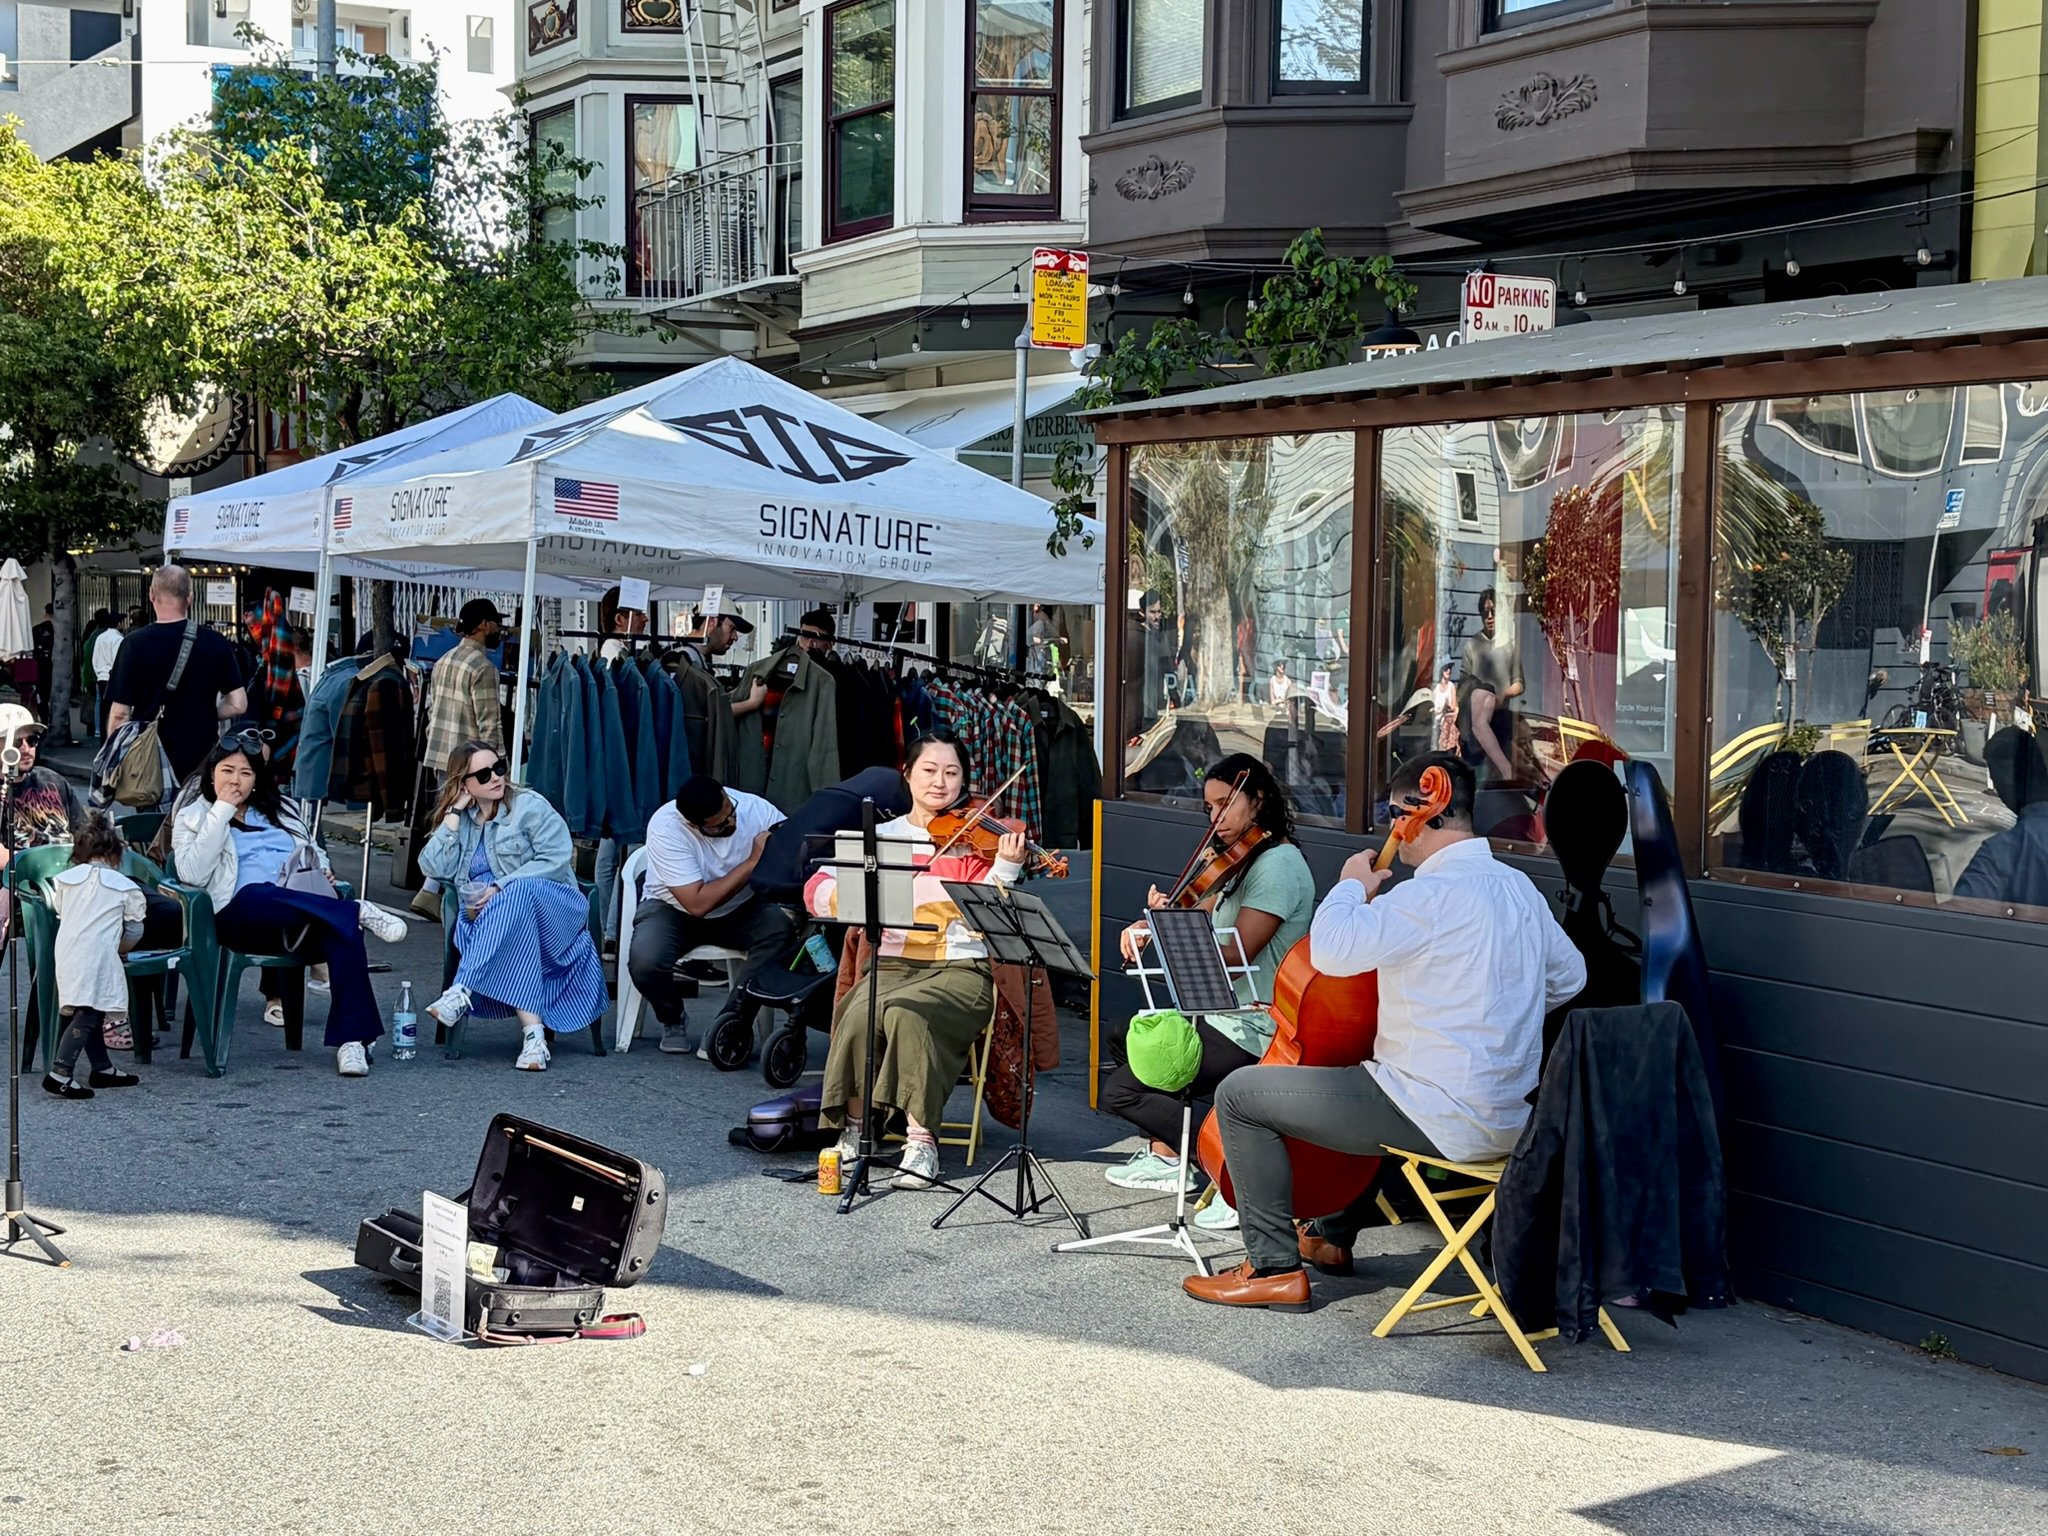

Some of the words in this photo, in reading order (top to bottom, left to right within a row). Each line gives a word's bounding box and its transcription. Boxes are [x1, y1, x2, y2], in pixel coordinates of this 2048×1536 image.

[1470, 277, 1493, 305] NO
[1497, 286, 1549, 309] PARKING
[1473, 311, 1483, 331] 8
[1513, 313, 1528, 333] 10
[215, 502, 264, 530] SIGNATURE
[390, 486, 452, 522] SIGNATURE
[759, 503, 933, 556] SIGNATURE
[756, 541, 867, 566] INNOVATION
[878, 554, 933, 574] GROUP
